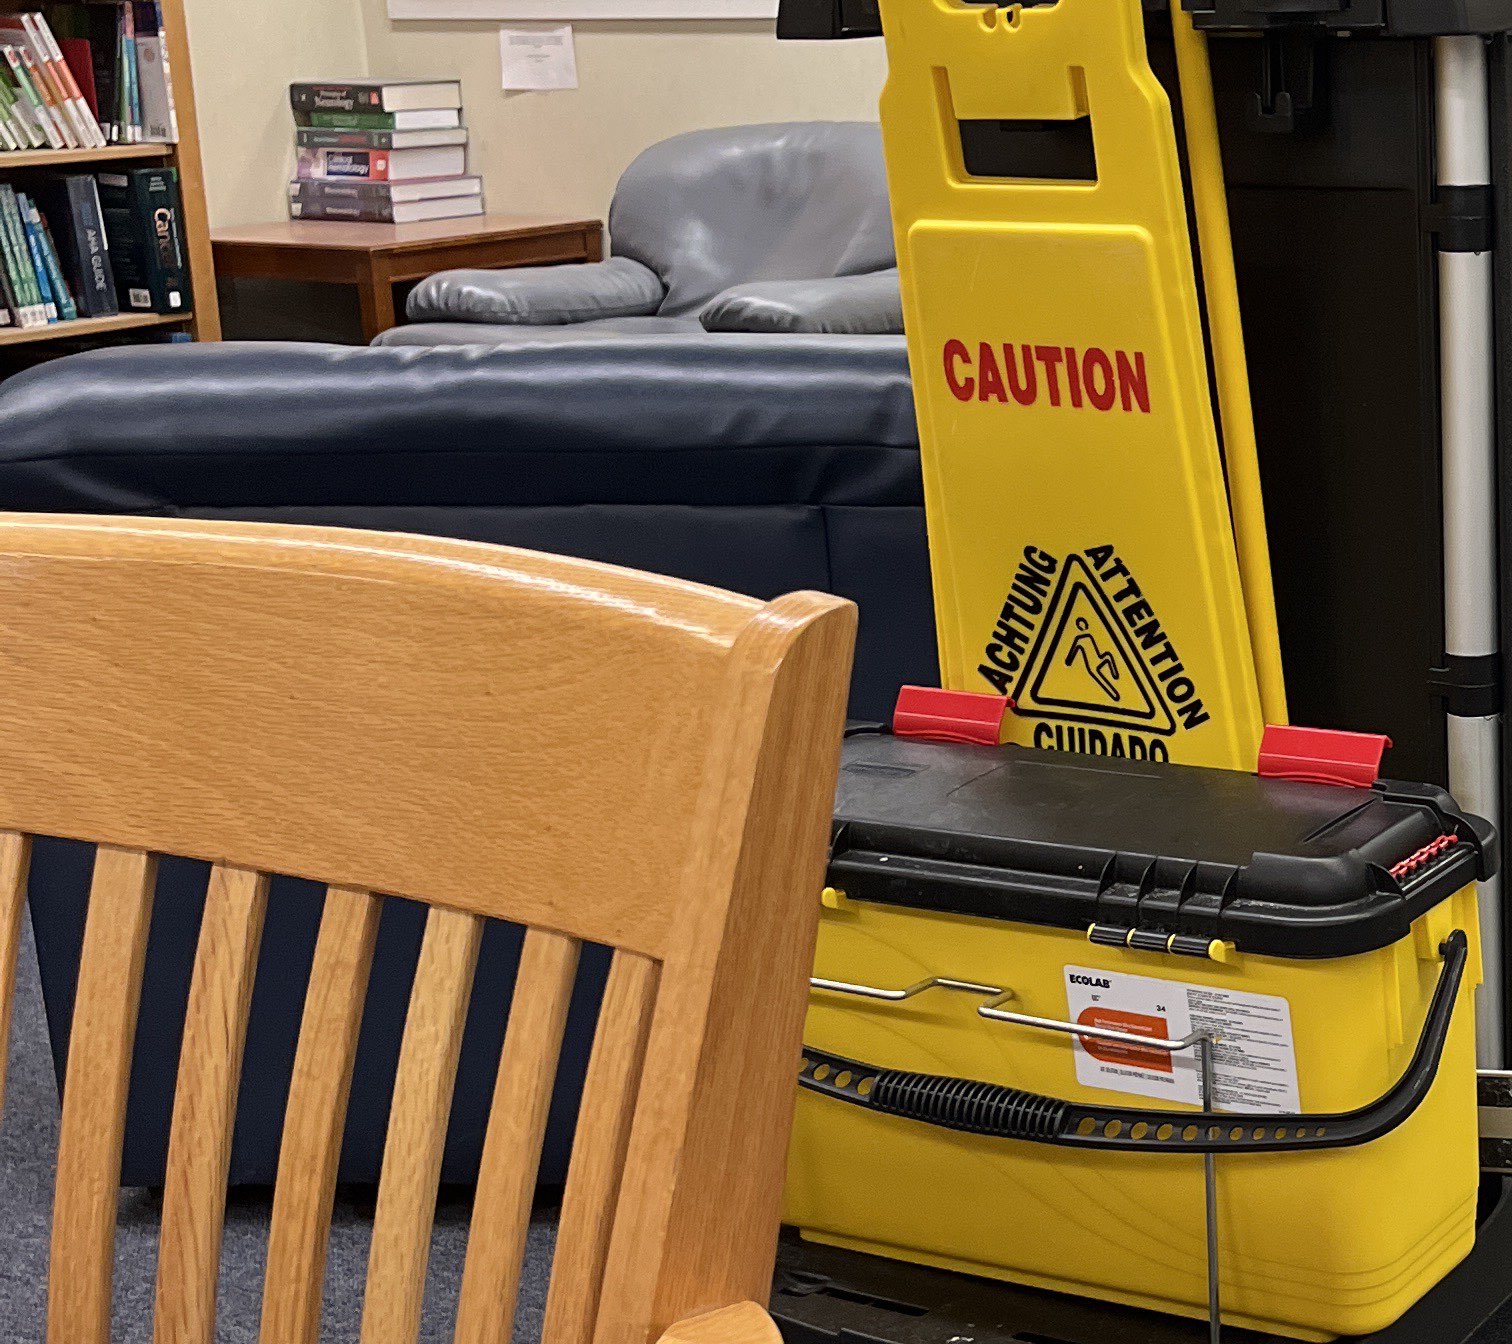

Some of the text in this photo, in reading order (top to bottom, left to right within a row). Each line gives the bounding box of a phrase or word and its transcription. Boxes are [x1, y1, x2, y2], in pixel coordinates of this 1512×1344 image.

[943, 338, 1151, 413] CAUTION
[977, 544, 1058, 694] ACHTUNG
[1084, 543, 1210, 731] ATTENTION
[1068, 973, 1111, 989] ECOLAB
